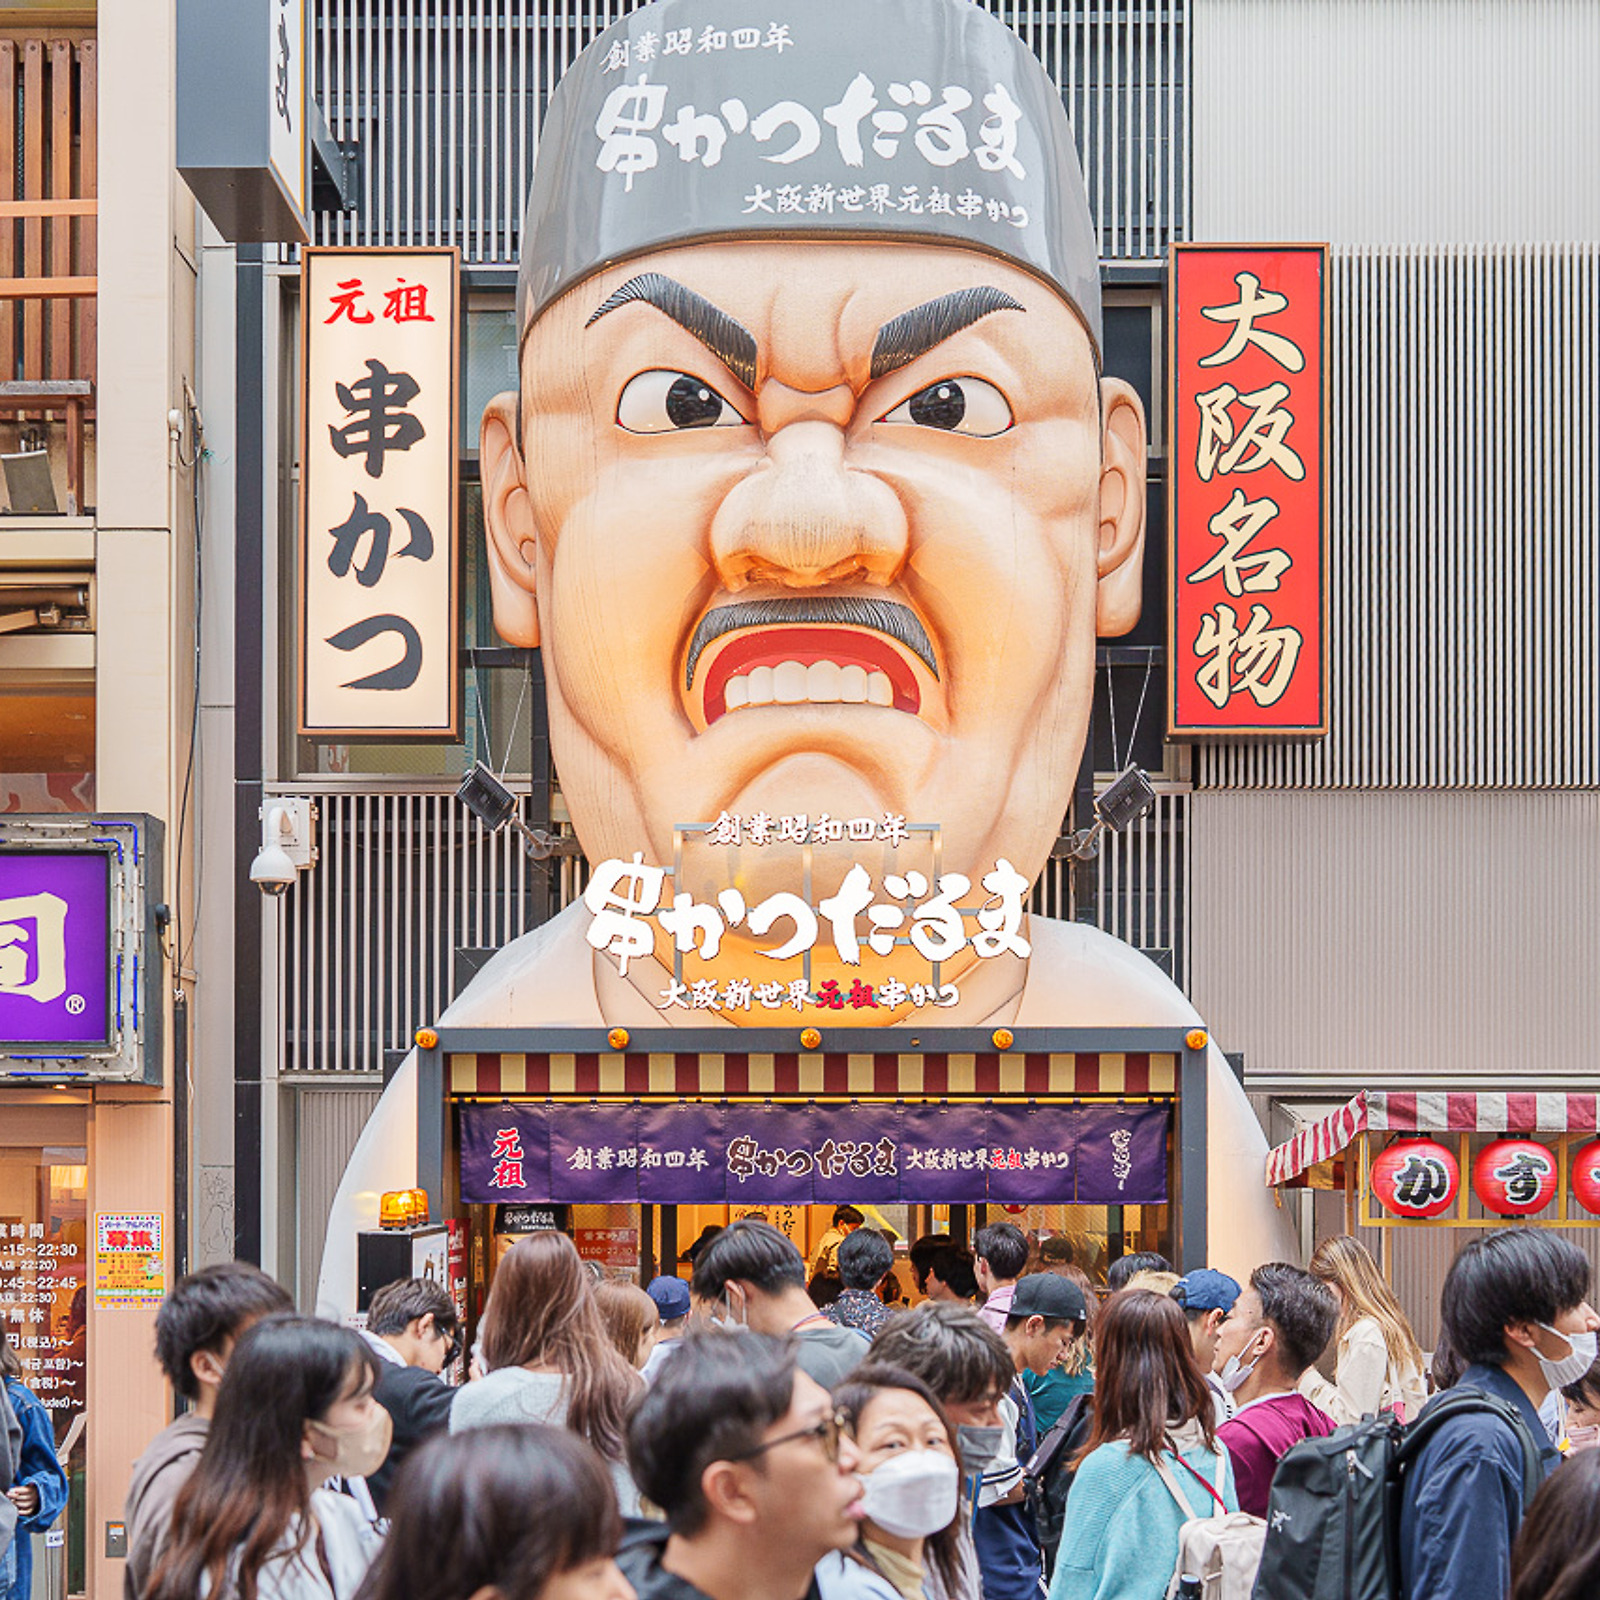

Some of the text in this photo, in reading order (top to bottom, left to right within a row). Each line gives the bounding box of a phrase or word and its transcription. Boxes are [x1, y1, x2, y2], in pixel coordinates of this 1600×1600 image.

[600, 22, 794, 74] 創業昭和四年
[595, 72, 1027, 192] 串かつだるま
[741, 183, 1029, 228] 大阪新世界元祖串かつ
[323, 278, 435, 324] 元祖
[1186, 271, 1306, 708] 大阪名物
[324, 358, 434, 691] 串かつ
[704, 811, 910, 848] 創業昭和四年
[584, 851, 1032, 977] 串かつだるま
[657, 977, 960, 1011] 大阪新世界元祖串かつ
[488, 1127, 527, 1188] 元祖
[567, 1147, 710, 1171] 創業昭和四年
[727, 1135, 898, 1182] 串かつだるま
[906, 1147, 1069, 1170] 大阪新世界元祖串かつ
[0, 1243, 78, 1257] :15～22:30
[0, 1276, 78, 1290] :45～22:45
